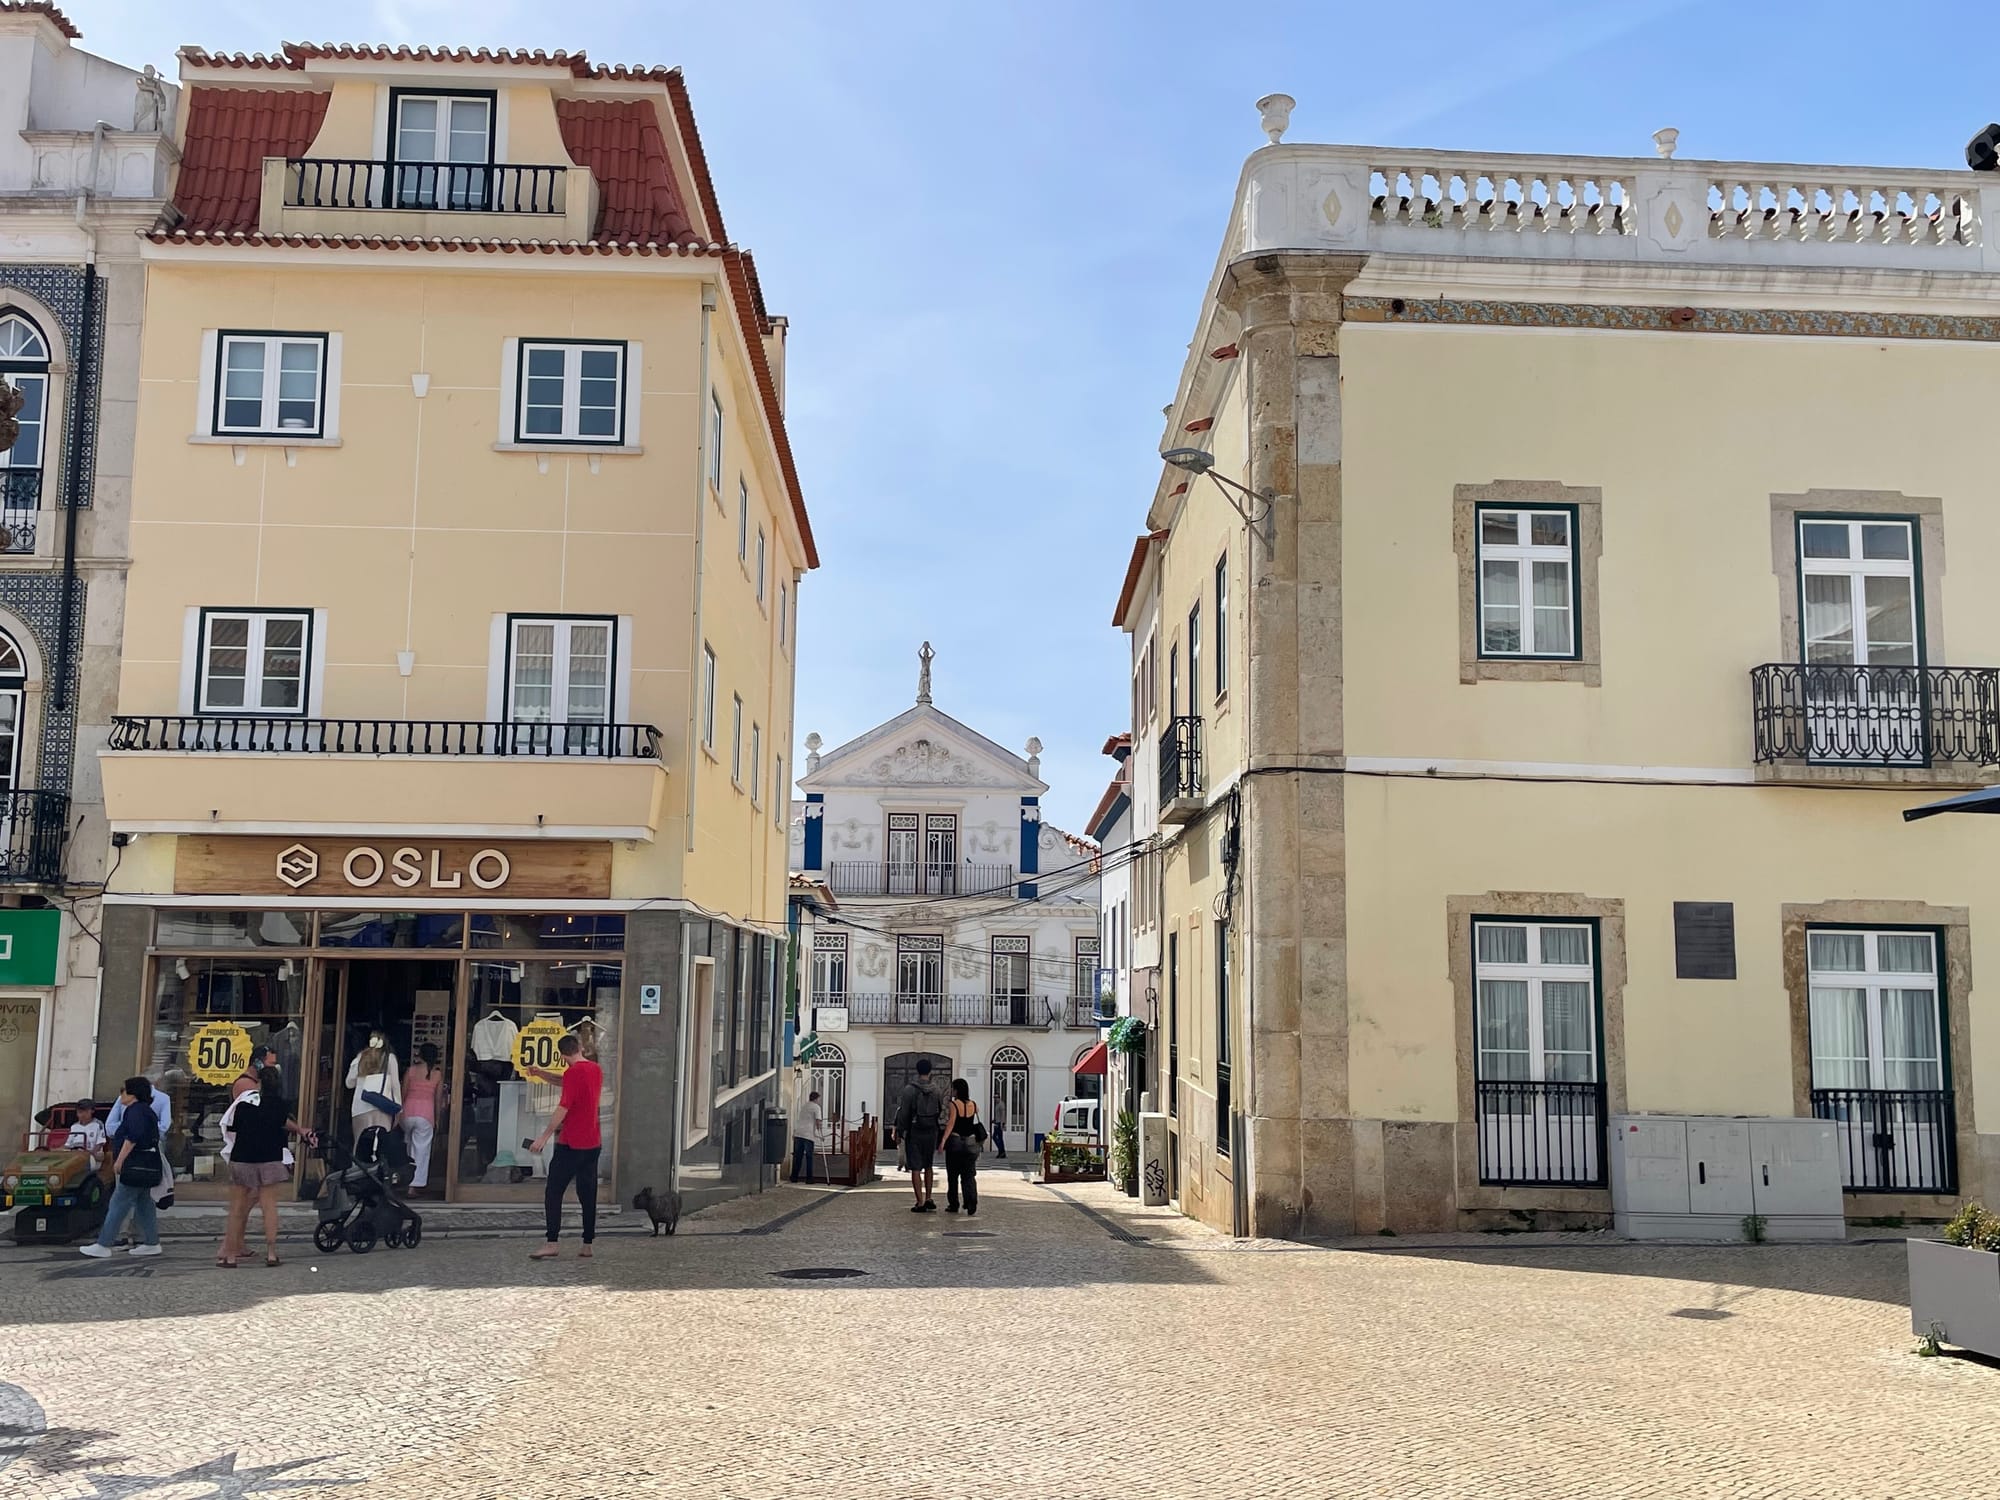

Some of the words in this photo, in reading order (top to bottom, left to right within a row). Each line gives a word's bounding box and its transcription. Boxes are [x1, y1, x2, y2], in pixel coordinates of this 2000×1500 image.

[343, 846, 511, 890] OSLO
[197, 1037, 245, 1069] 50%
[520, 1035, 567, 1068] 50%
